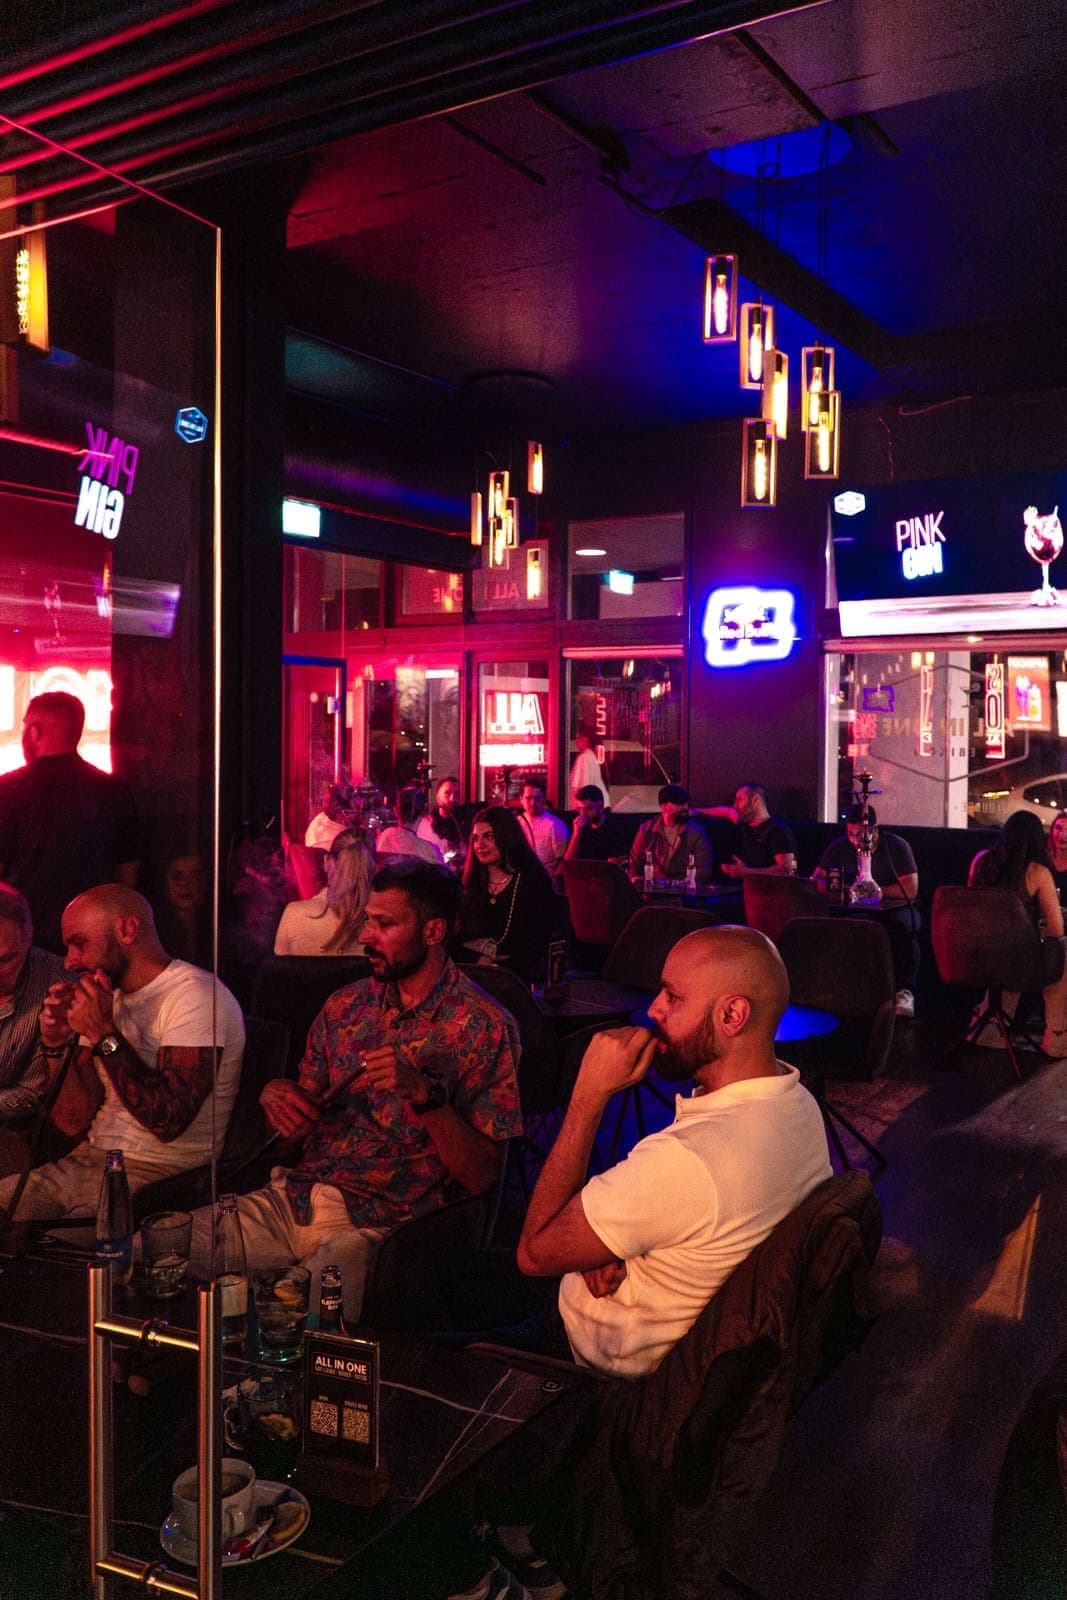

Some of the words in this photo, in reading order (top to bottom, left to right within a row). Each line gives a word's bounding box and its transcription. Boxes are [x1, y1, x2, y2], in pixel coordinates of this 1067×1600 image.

[895, 510, 947, 552] PINK
[902, 541, 943, 580] GIN
[315, 1355, 333, 1368] ALL
[334, 1359, 345, 1371] IN
[346, 1362, 367, 1375] ONE
